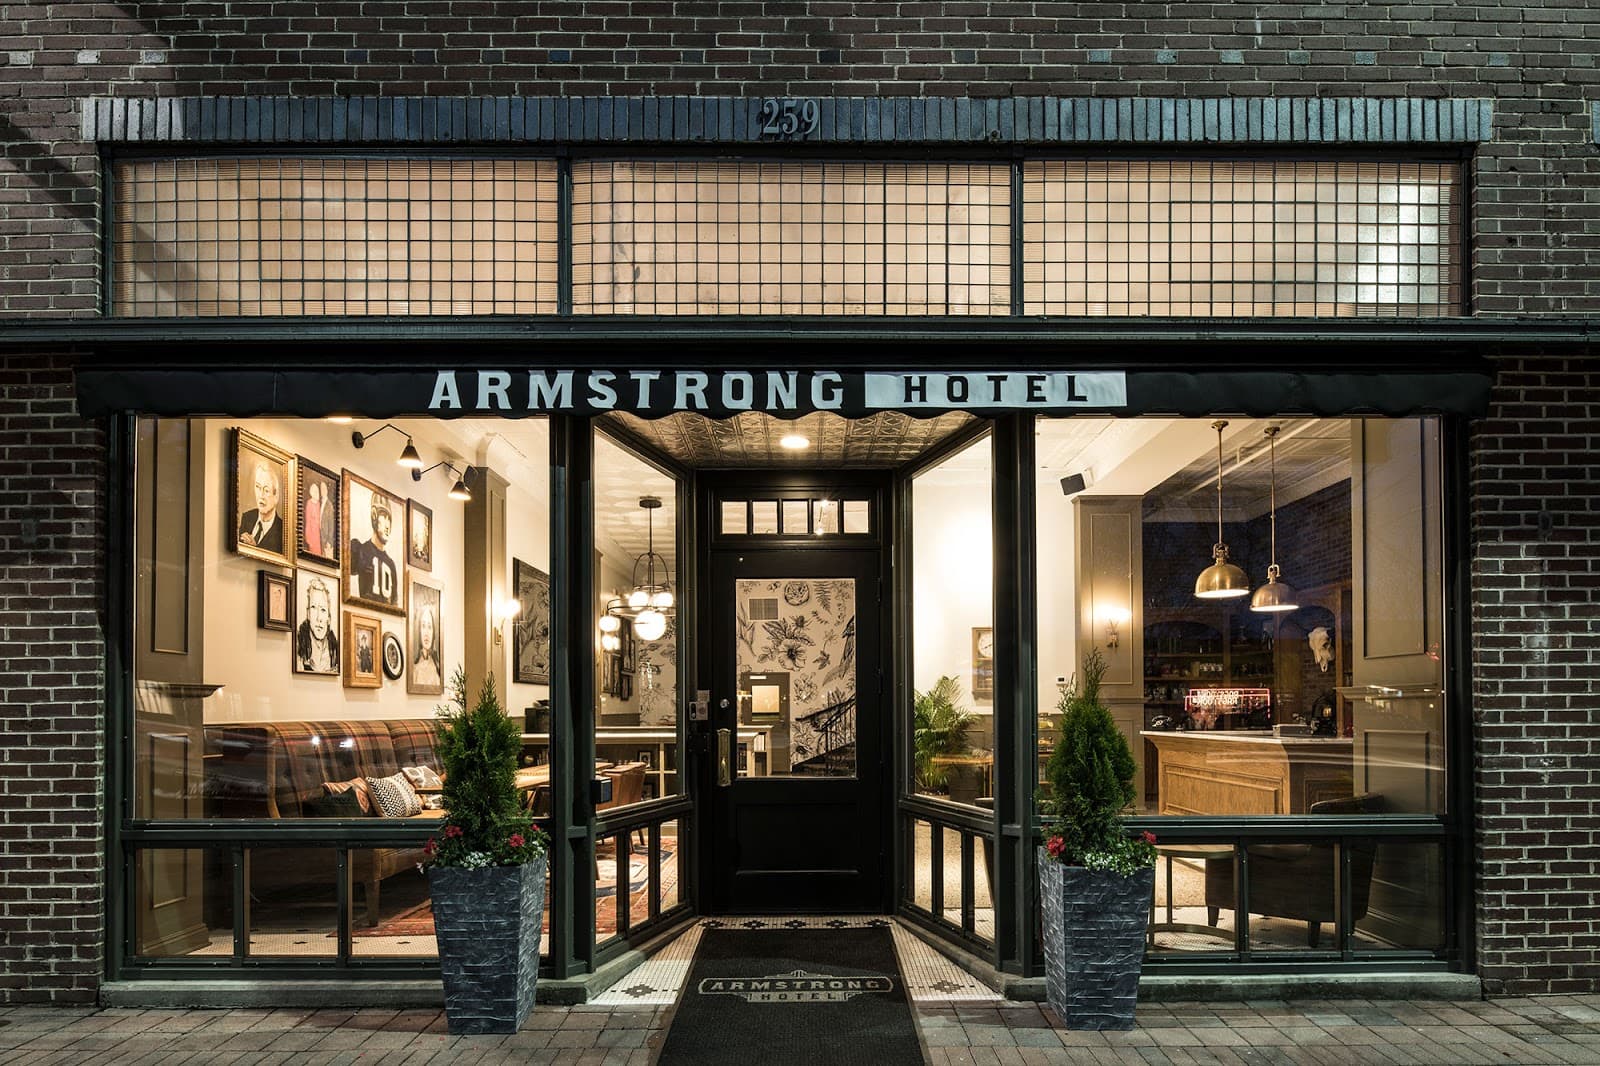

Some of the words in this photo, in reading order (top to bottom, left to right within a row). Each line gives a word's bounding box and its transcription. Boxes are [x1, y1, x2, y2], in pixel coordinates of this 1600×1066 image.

[764, 100, 819, 134] 259
[428, 368, 844, 410] ARMSTRONG
[903, 375, 1088, 403] HOTEL
[372, 556, 393, 598] 10
[710, 980, 881, 991] ARMSTRONG
[761, 993, 836, 1001] HOTEL
